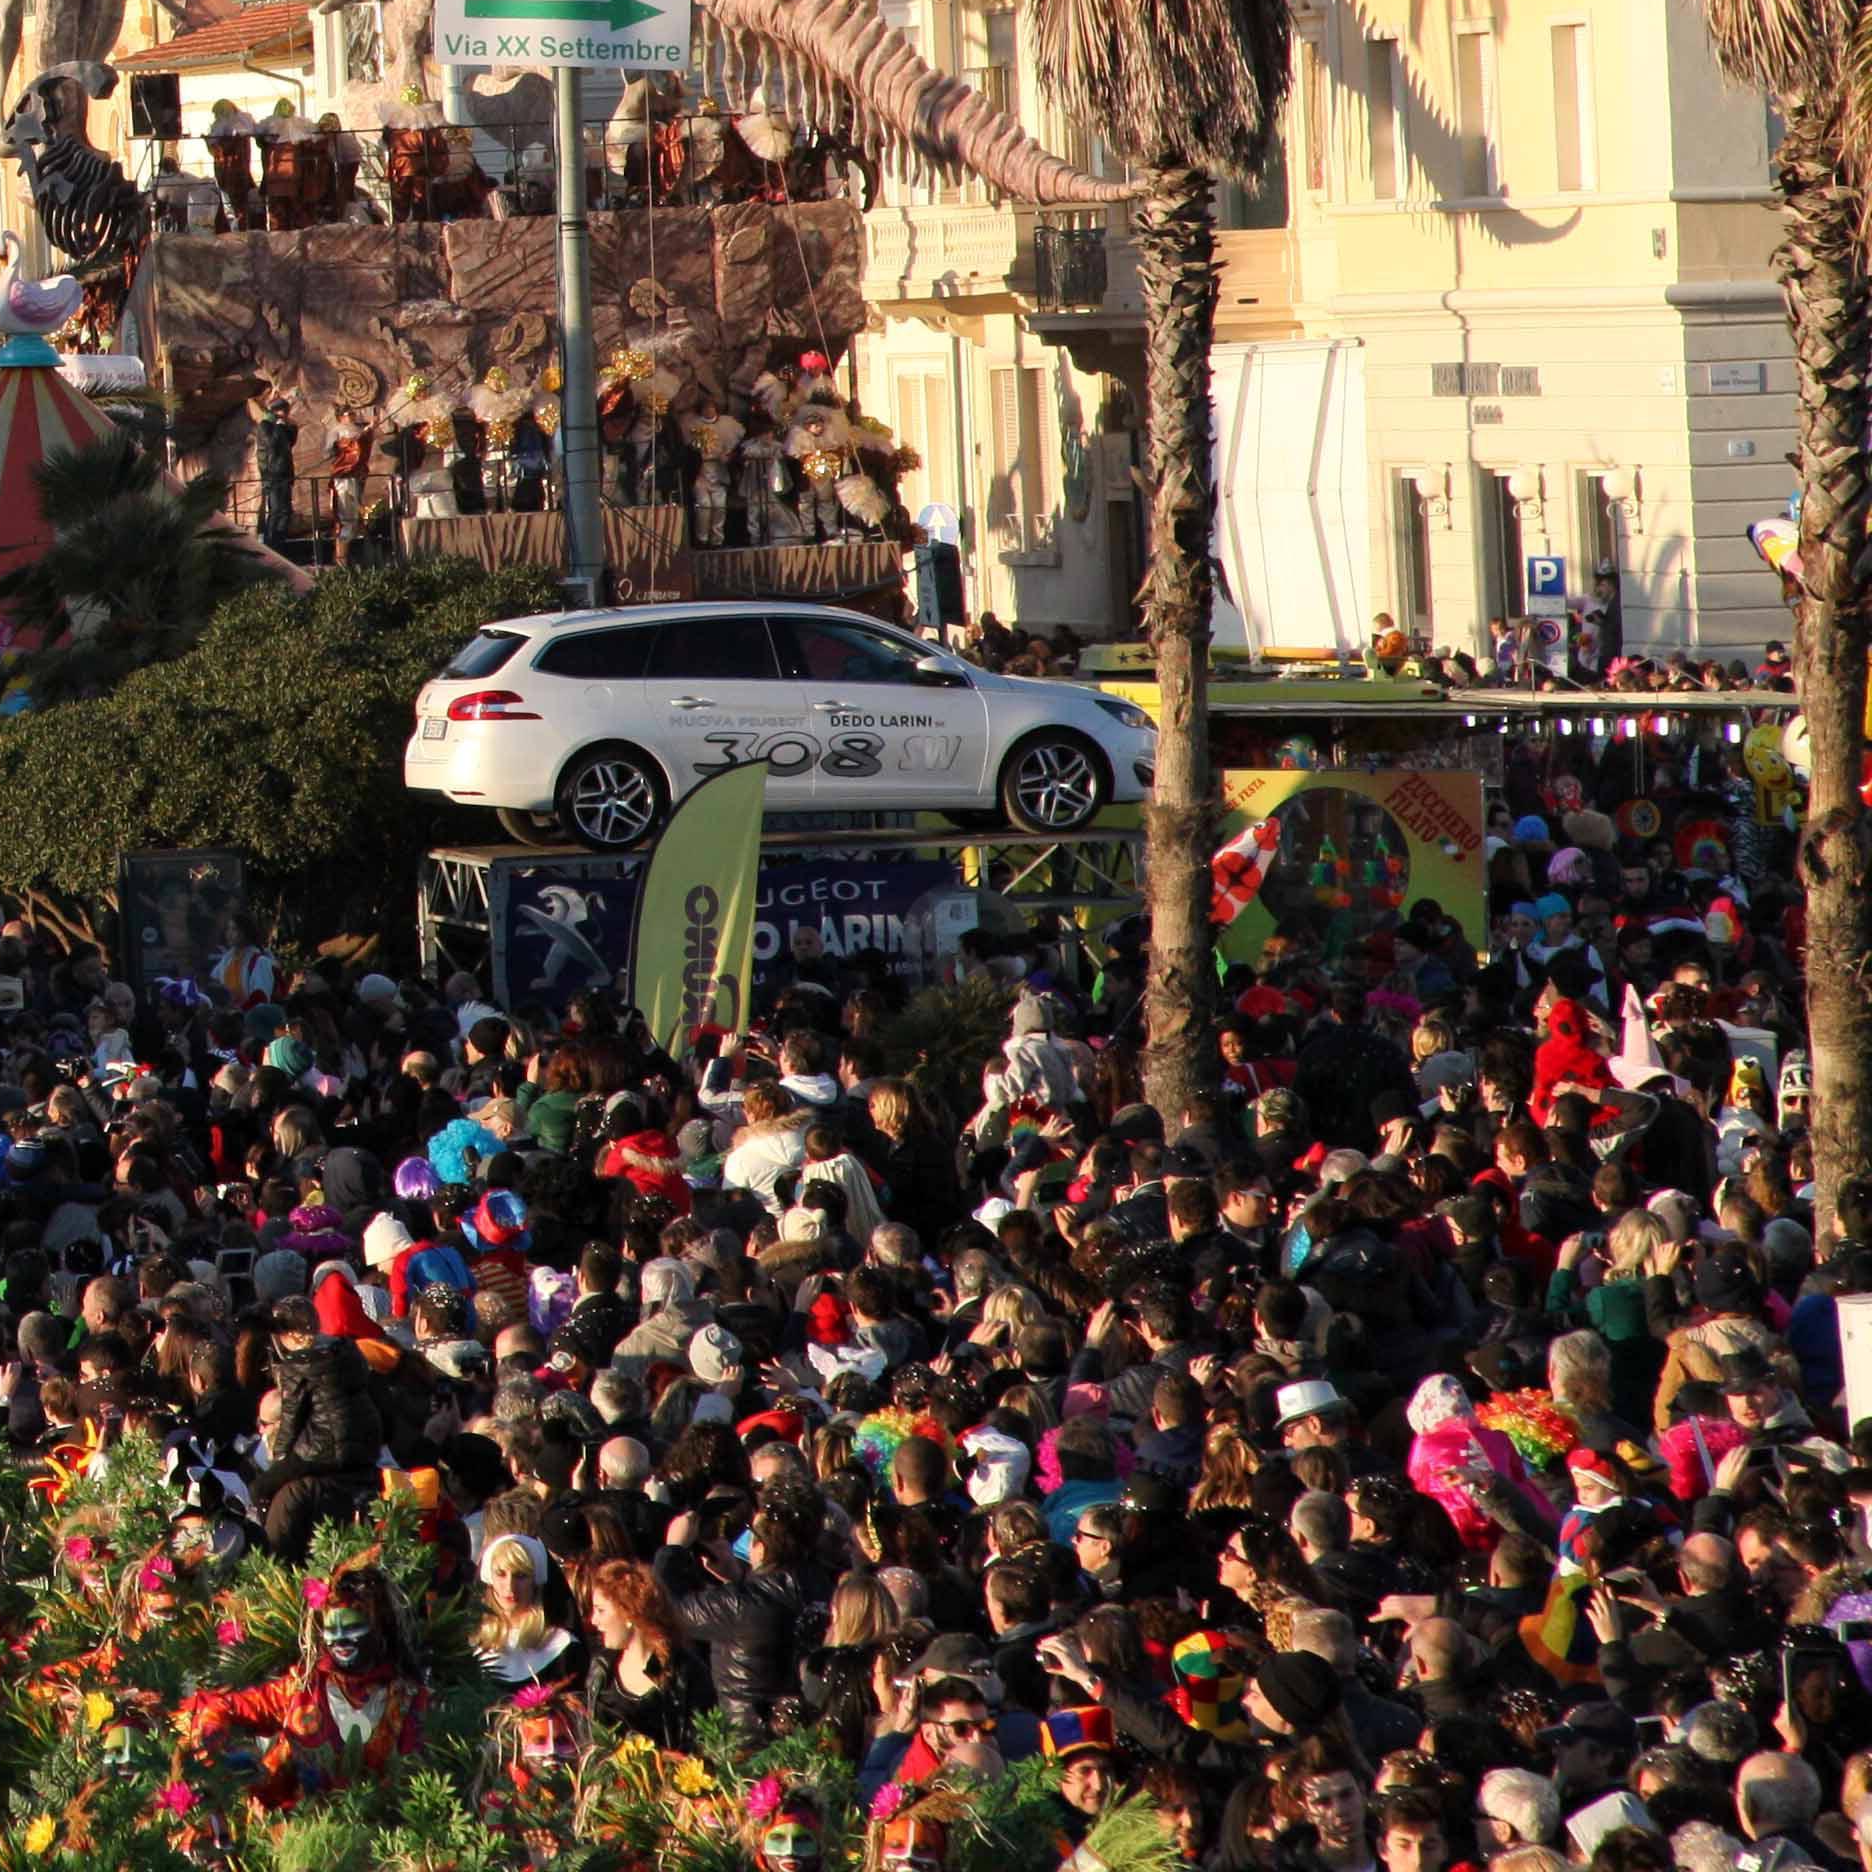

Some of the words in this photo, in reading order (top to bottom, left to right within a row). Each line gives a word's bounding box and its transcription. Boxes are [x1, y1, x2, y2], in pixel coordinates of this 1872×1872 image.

[443, 32, 488, 58] Via
[495, 34, 532, 58] XX
[539, 34, 682, 62] Settembre
[830, 714, 875, 728] DEDO
[879, 714, 933, 728] LARINI
[692, 731, 886, 777] 308
[897, 734, 962, 771] SW
[1400, 770, 1484, 853] ZUCCHERO
